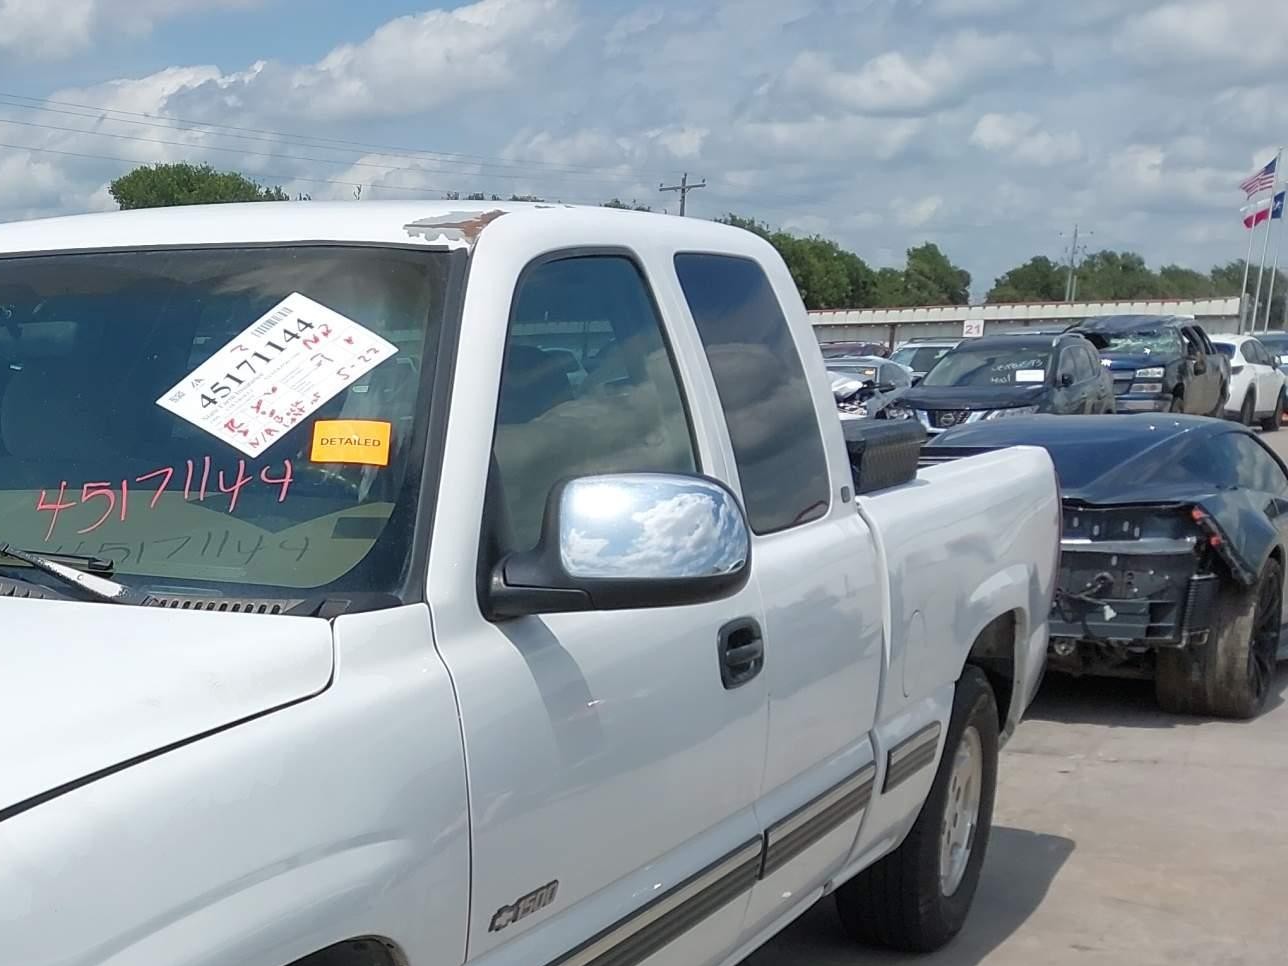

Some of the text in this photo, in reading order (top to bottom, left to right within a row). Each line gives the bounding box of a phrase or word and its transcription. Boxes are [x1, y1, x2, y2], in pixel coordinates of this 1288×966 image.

[965, 324, 981, 335] 21
[200, 317, 315, 409] 45171144
[320, 437, 382, 448] DETAILED
[36, 456, 294, 542] 45171144
